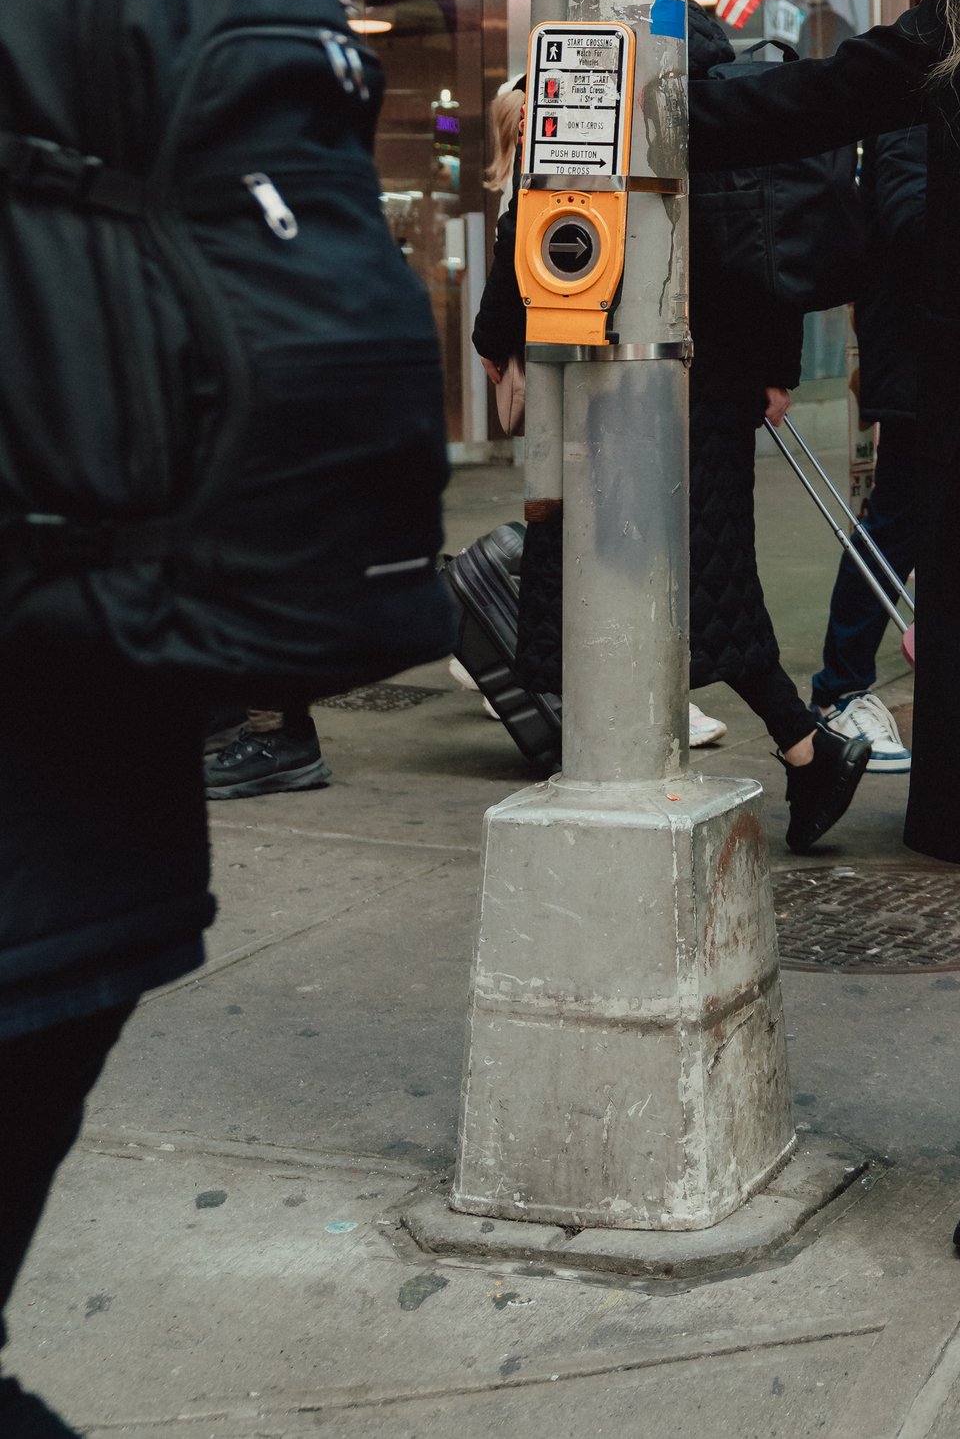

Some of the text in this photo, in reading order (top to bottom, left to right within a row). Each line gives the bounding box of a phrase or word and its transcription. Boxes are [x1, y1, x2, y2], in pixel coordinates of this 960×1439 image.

[567, 38, 613, 48] START CROSSING
[576, 49, 603, 57] Watch For
[571, 86, 587, 94] Finish
[586, 121, 604, 130] CROSS
[550, 149, 598, 159] PUSH BUTTON
[555, 167, 590, 175] TO CROSS
